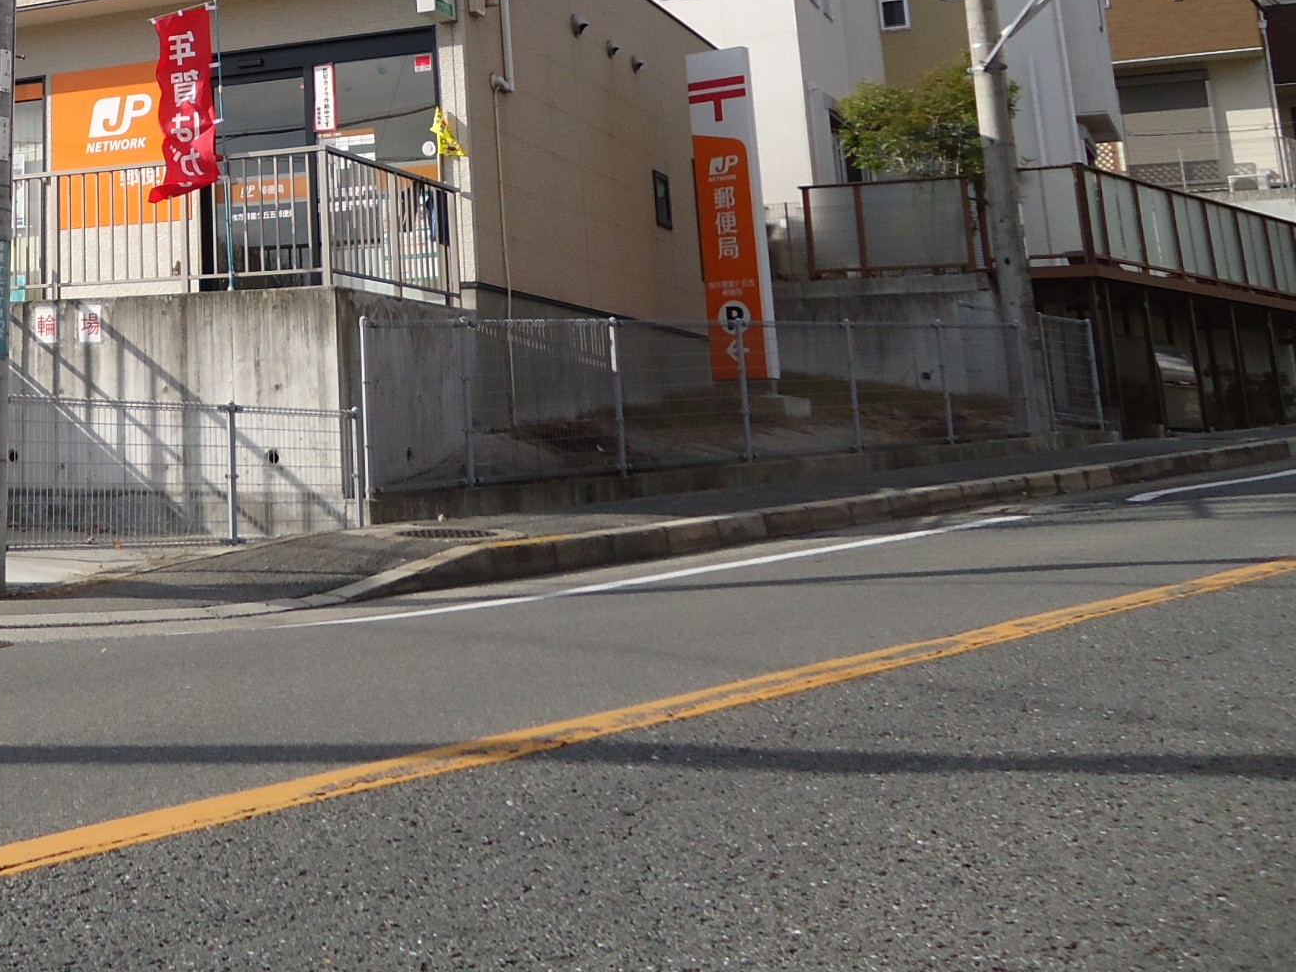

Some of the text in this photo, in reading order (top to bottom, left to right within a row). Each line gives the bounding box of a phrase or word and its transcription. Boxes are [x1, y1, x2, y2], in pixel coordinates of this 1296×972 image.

[88, 93, 153, 139] JP
[85, 136, 147, 154] NETWORK
[708, 154, 740, 176] JP
[713, 186, 740, 261] 郵便局
